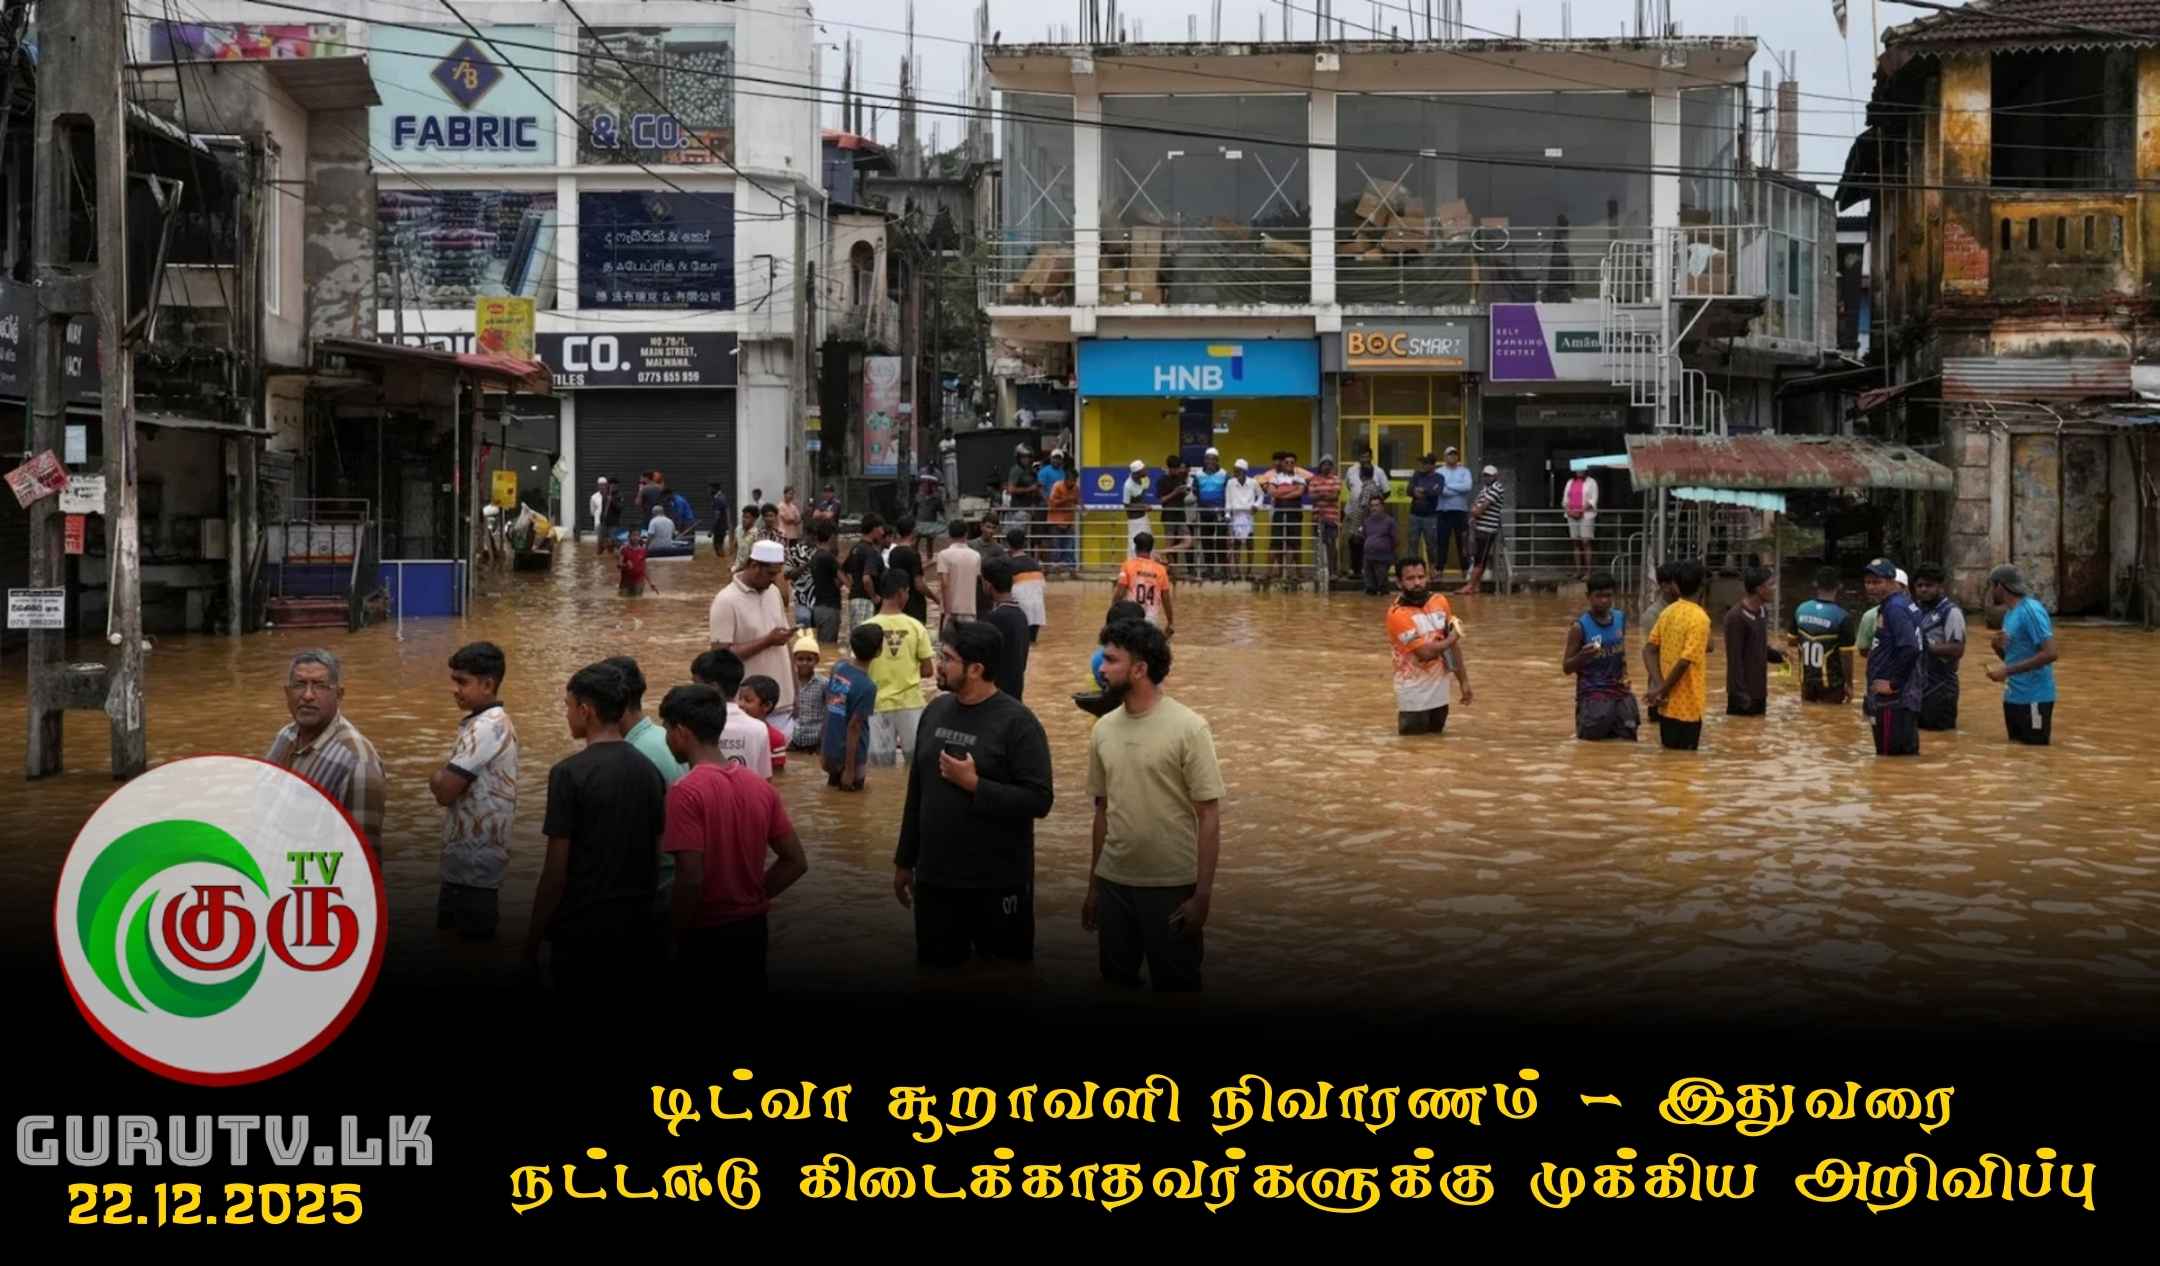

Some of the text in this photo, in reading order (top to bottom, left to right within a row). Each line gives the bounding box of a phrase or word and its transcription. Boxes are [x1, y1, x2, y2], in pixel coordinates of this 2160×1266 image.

[391, 113, 689, 150] FABRIC & CO.
[563, 336, 631, 372] CO.
[640, 347, 664, 357] MAIN
[1348, 331, 1408, 357] BOC
[1154, 365, 1224, 392] HNB
[1136, 583, 1156, 606] 04
[1802, 641, 1825, 669] 10
